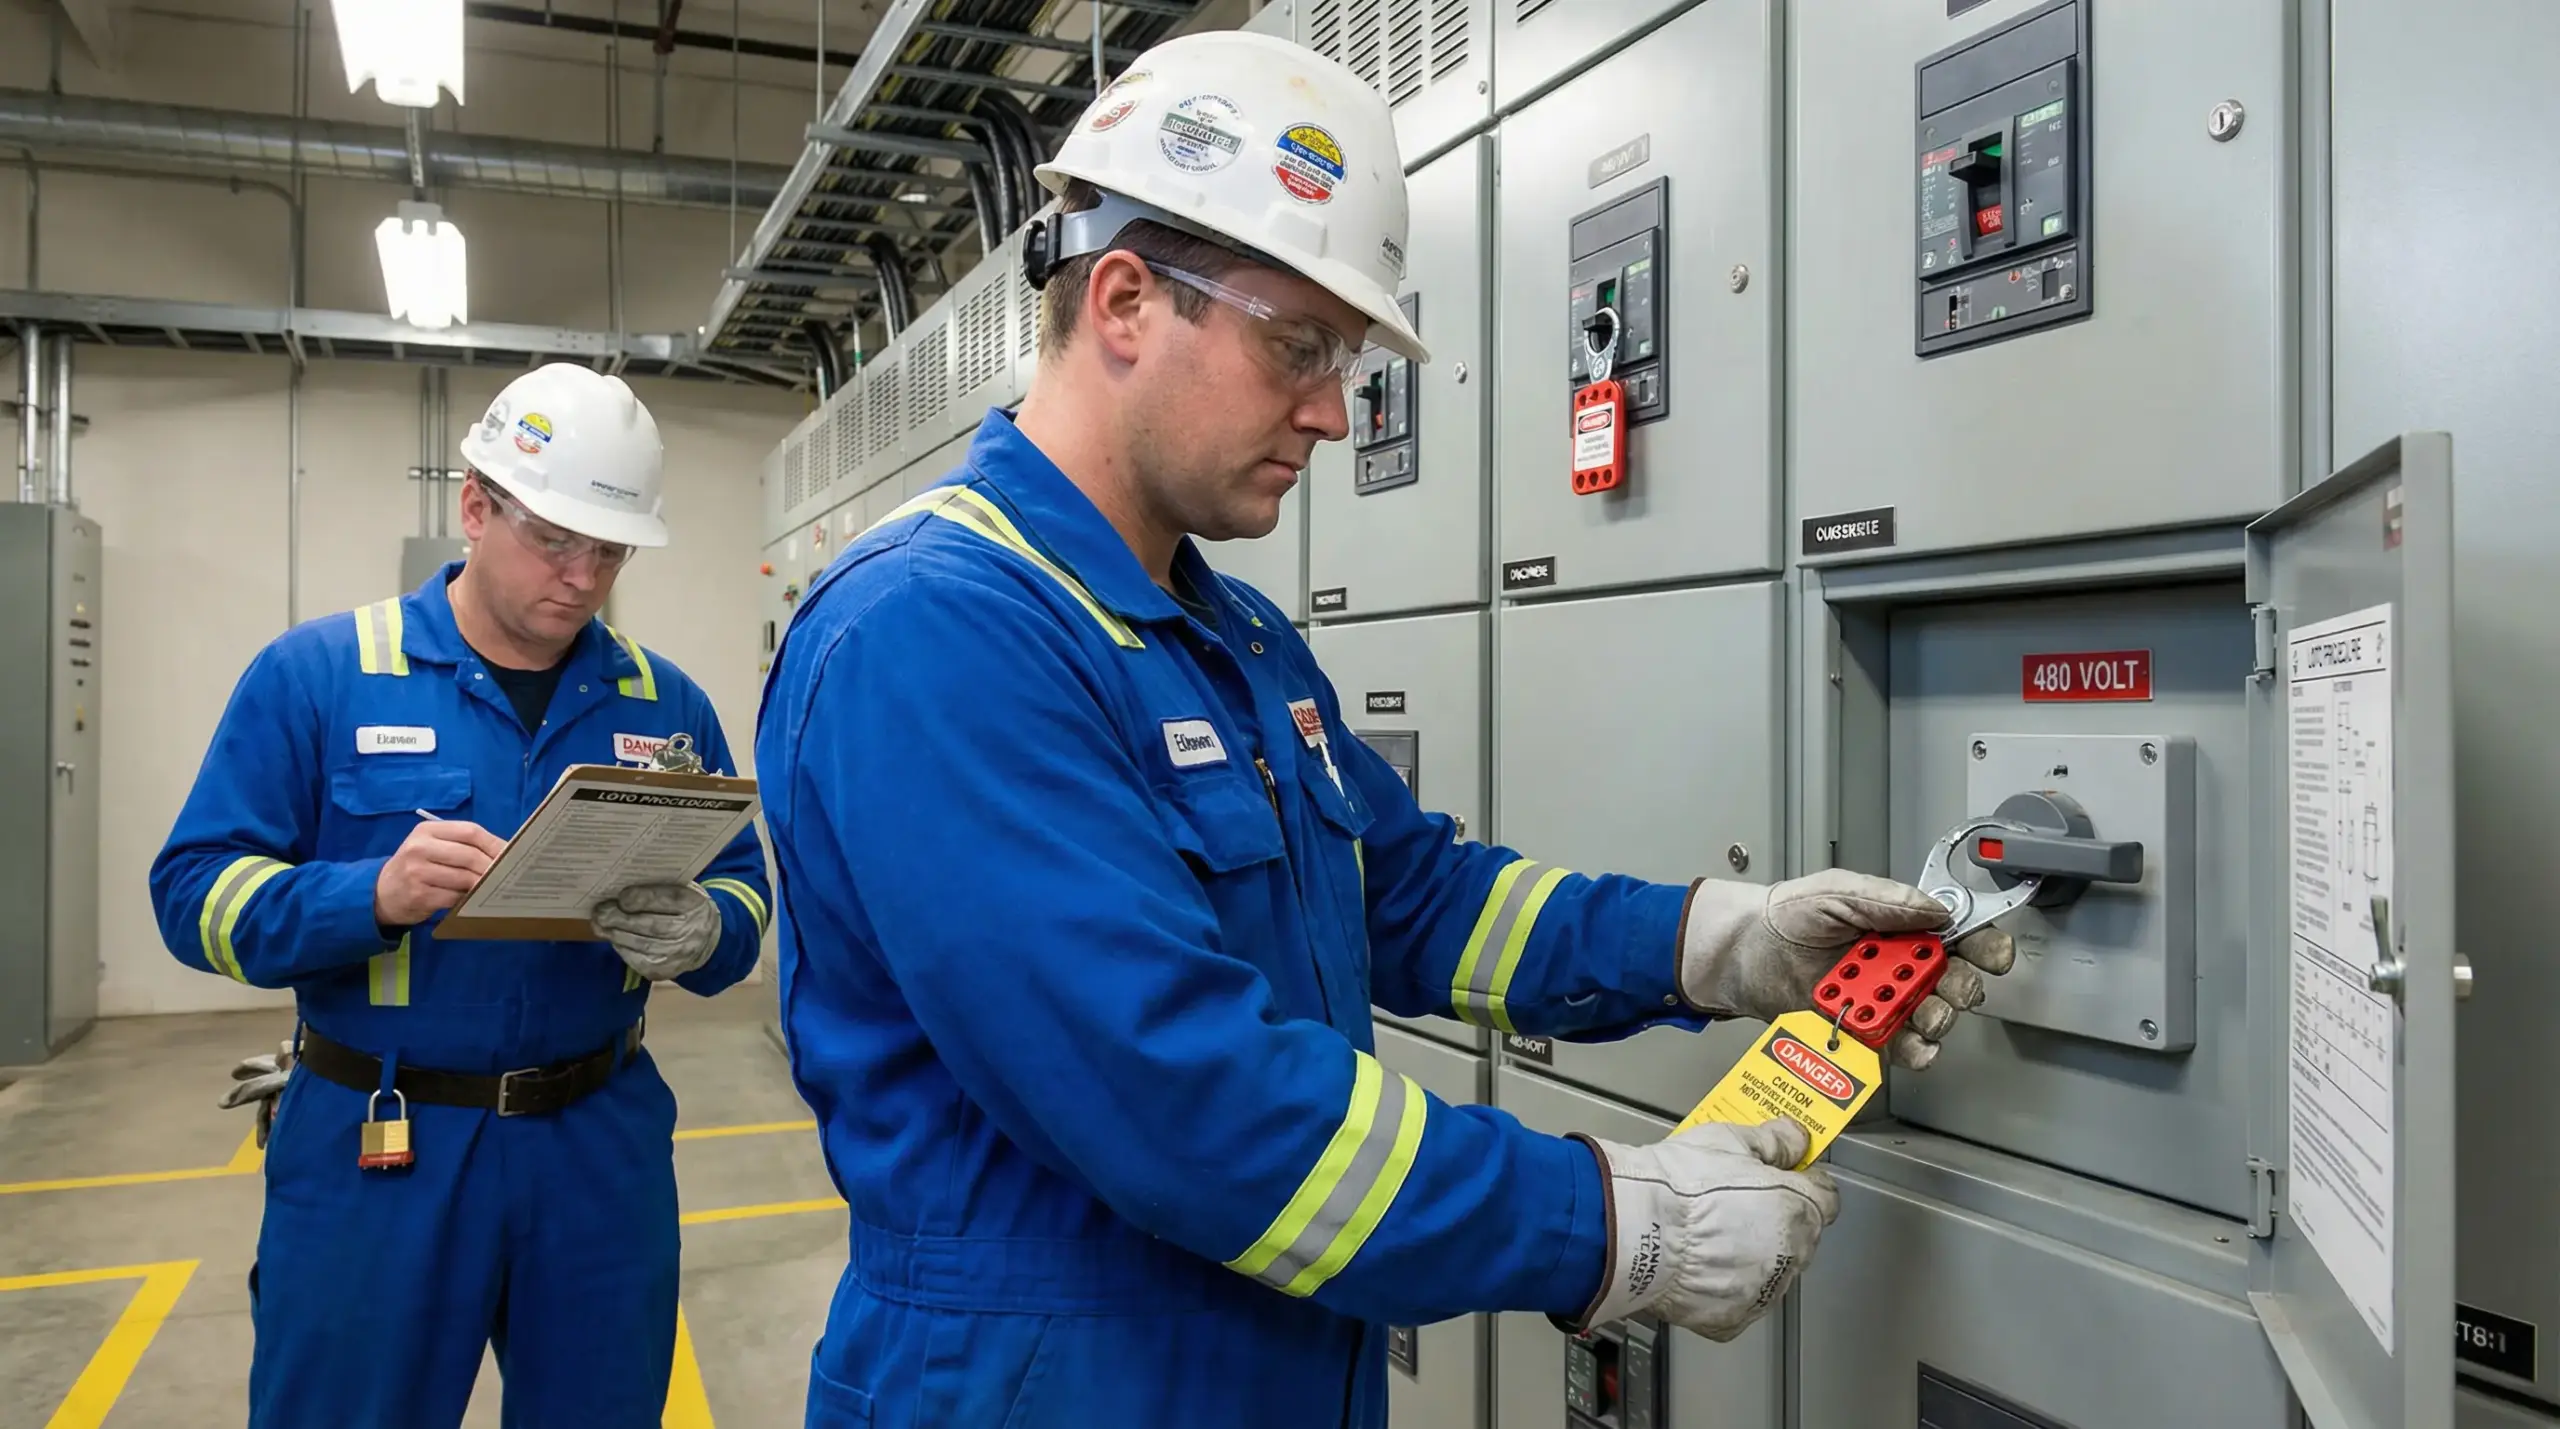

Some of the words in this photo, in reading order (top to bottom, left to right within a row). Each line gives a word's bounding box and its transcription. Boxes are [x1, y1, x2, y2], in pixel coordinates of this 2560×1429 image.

[2033, 661, 2071, 692] 480
[2079, 660, 2139, 690] VOLT
[597, 791, 638, 803] LOTO
[1779, 1043, 1846, 1095] DANGER
